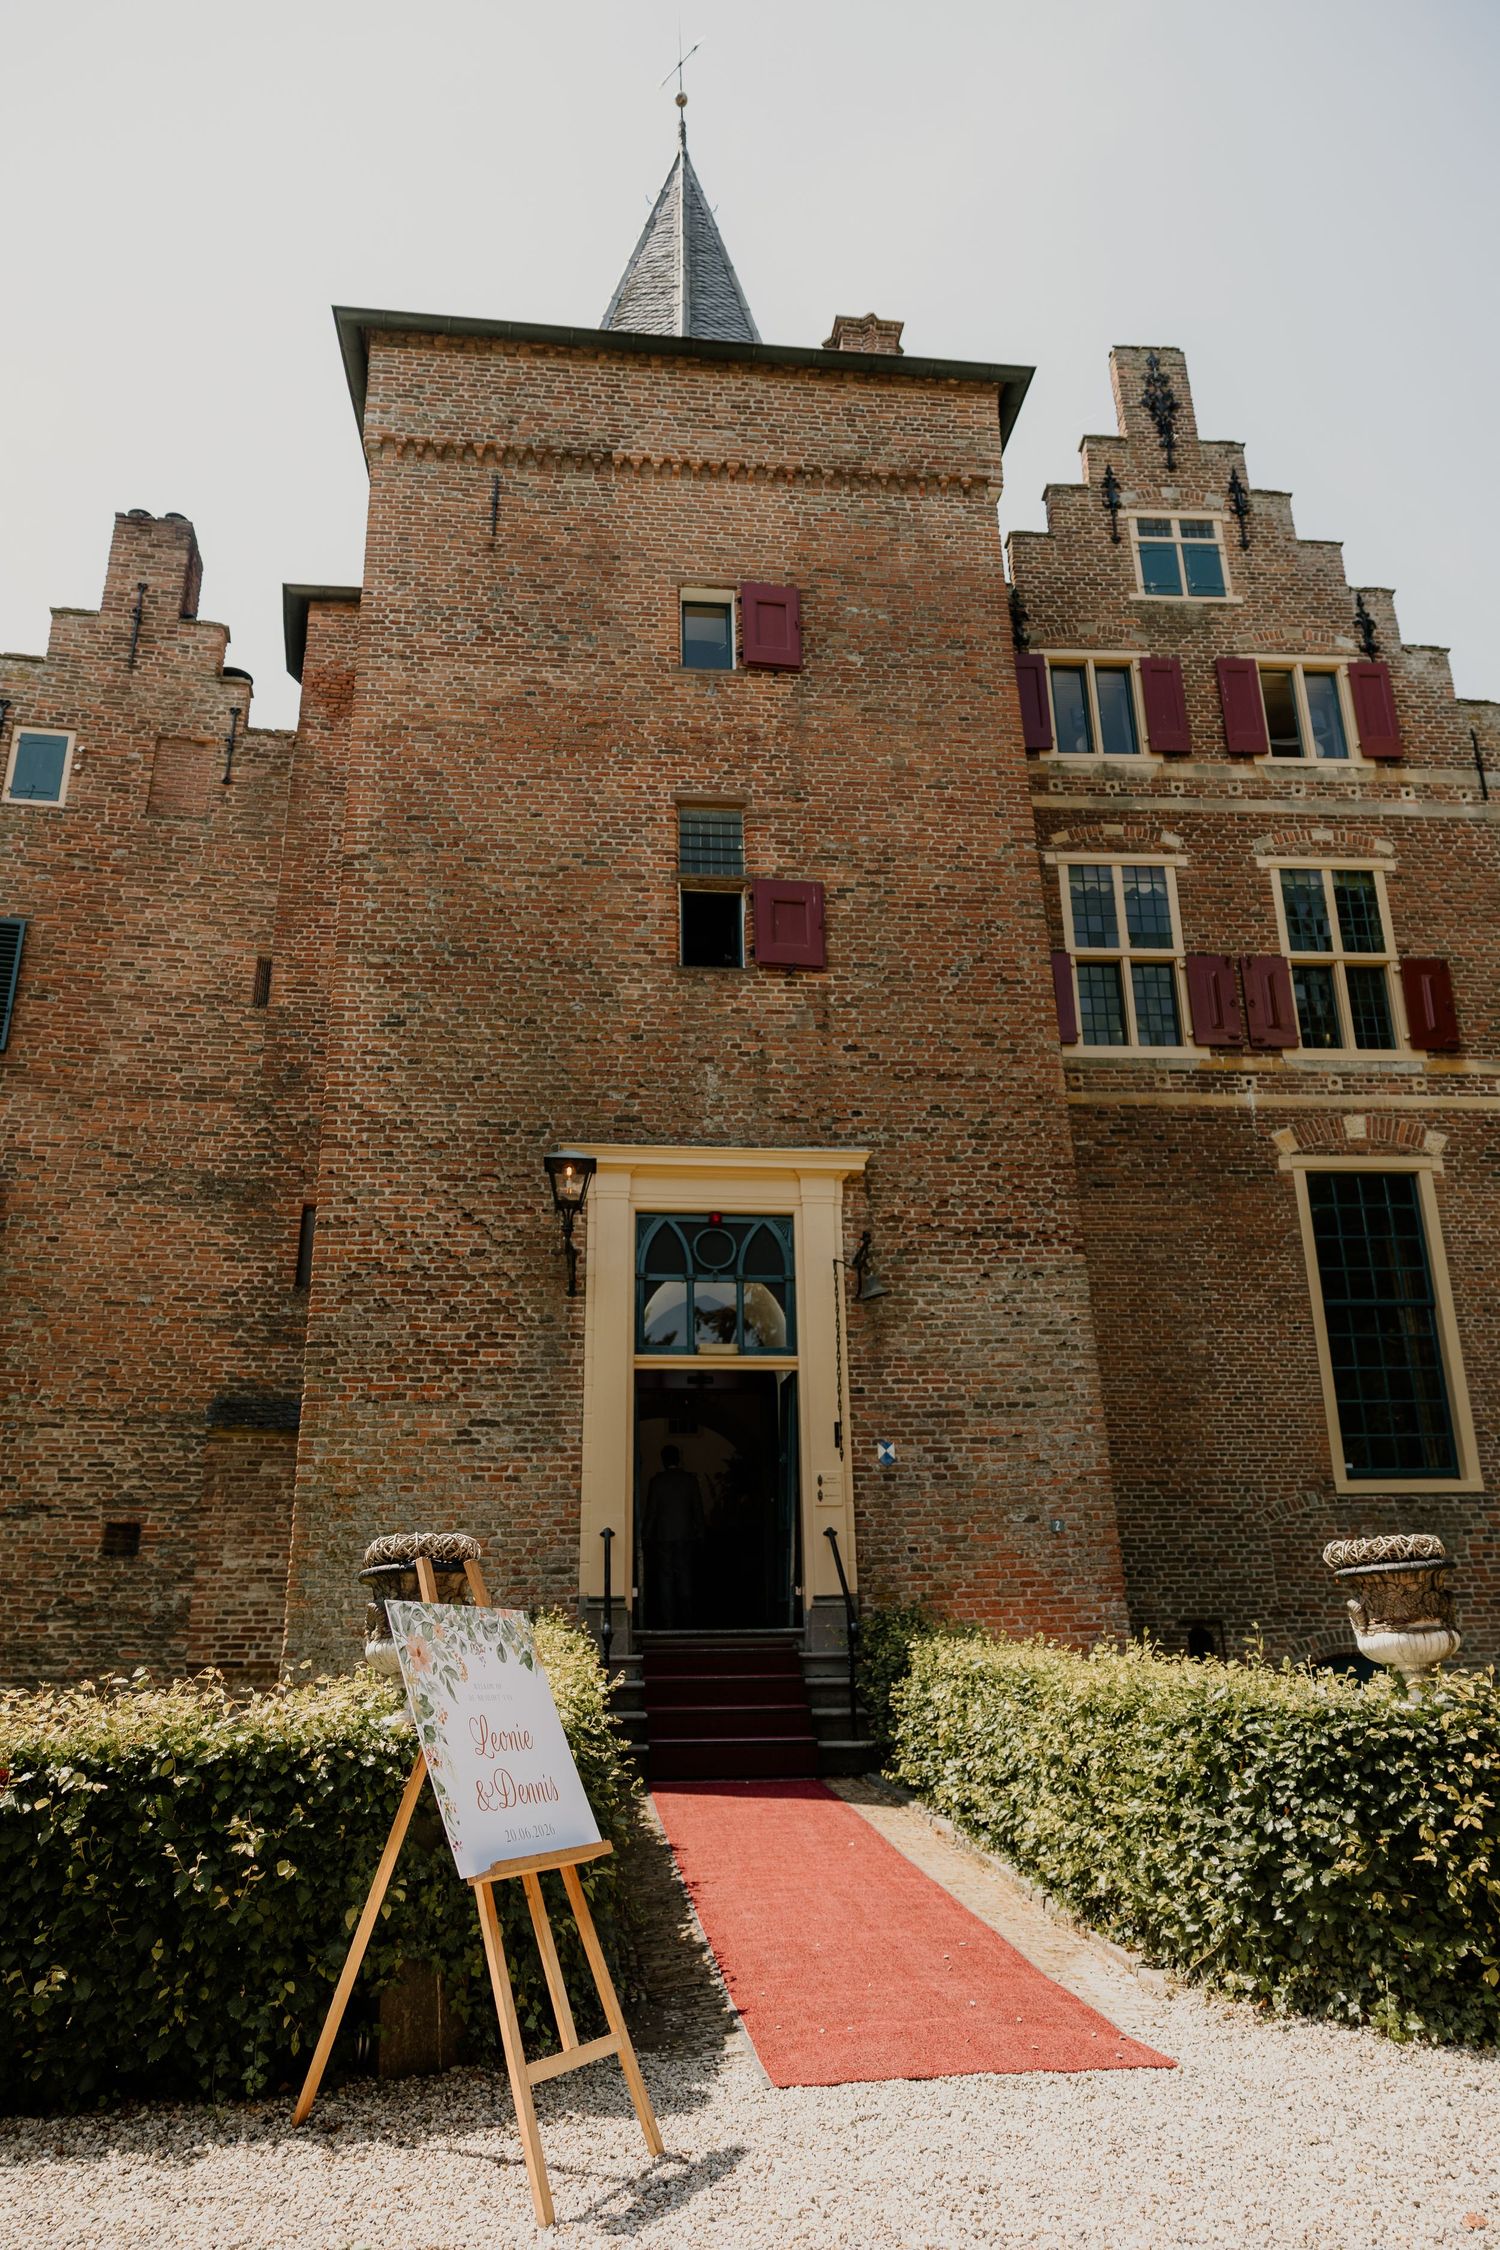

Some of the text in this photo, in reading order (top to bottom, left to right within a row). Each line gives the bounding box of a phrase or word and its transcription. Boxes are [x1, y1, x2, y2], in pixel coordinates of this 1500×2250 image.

[1055, 1520, 1061, 1531] 2
[469, 1715, 533, 1759] Leonie
[504, 1823, 556, 1843] 20.06.2026
